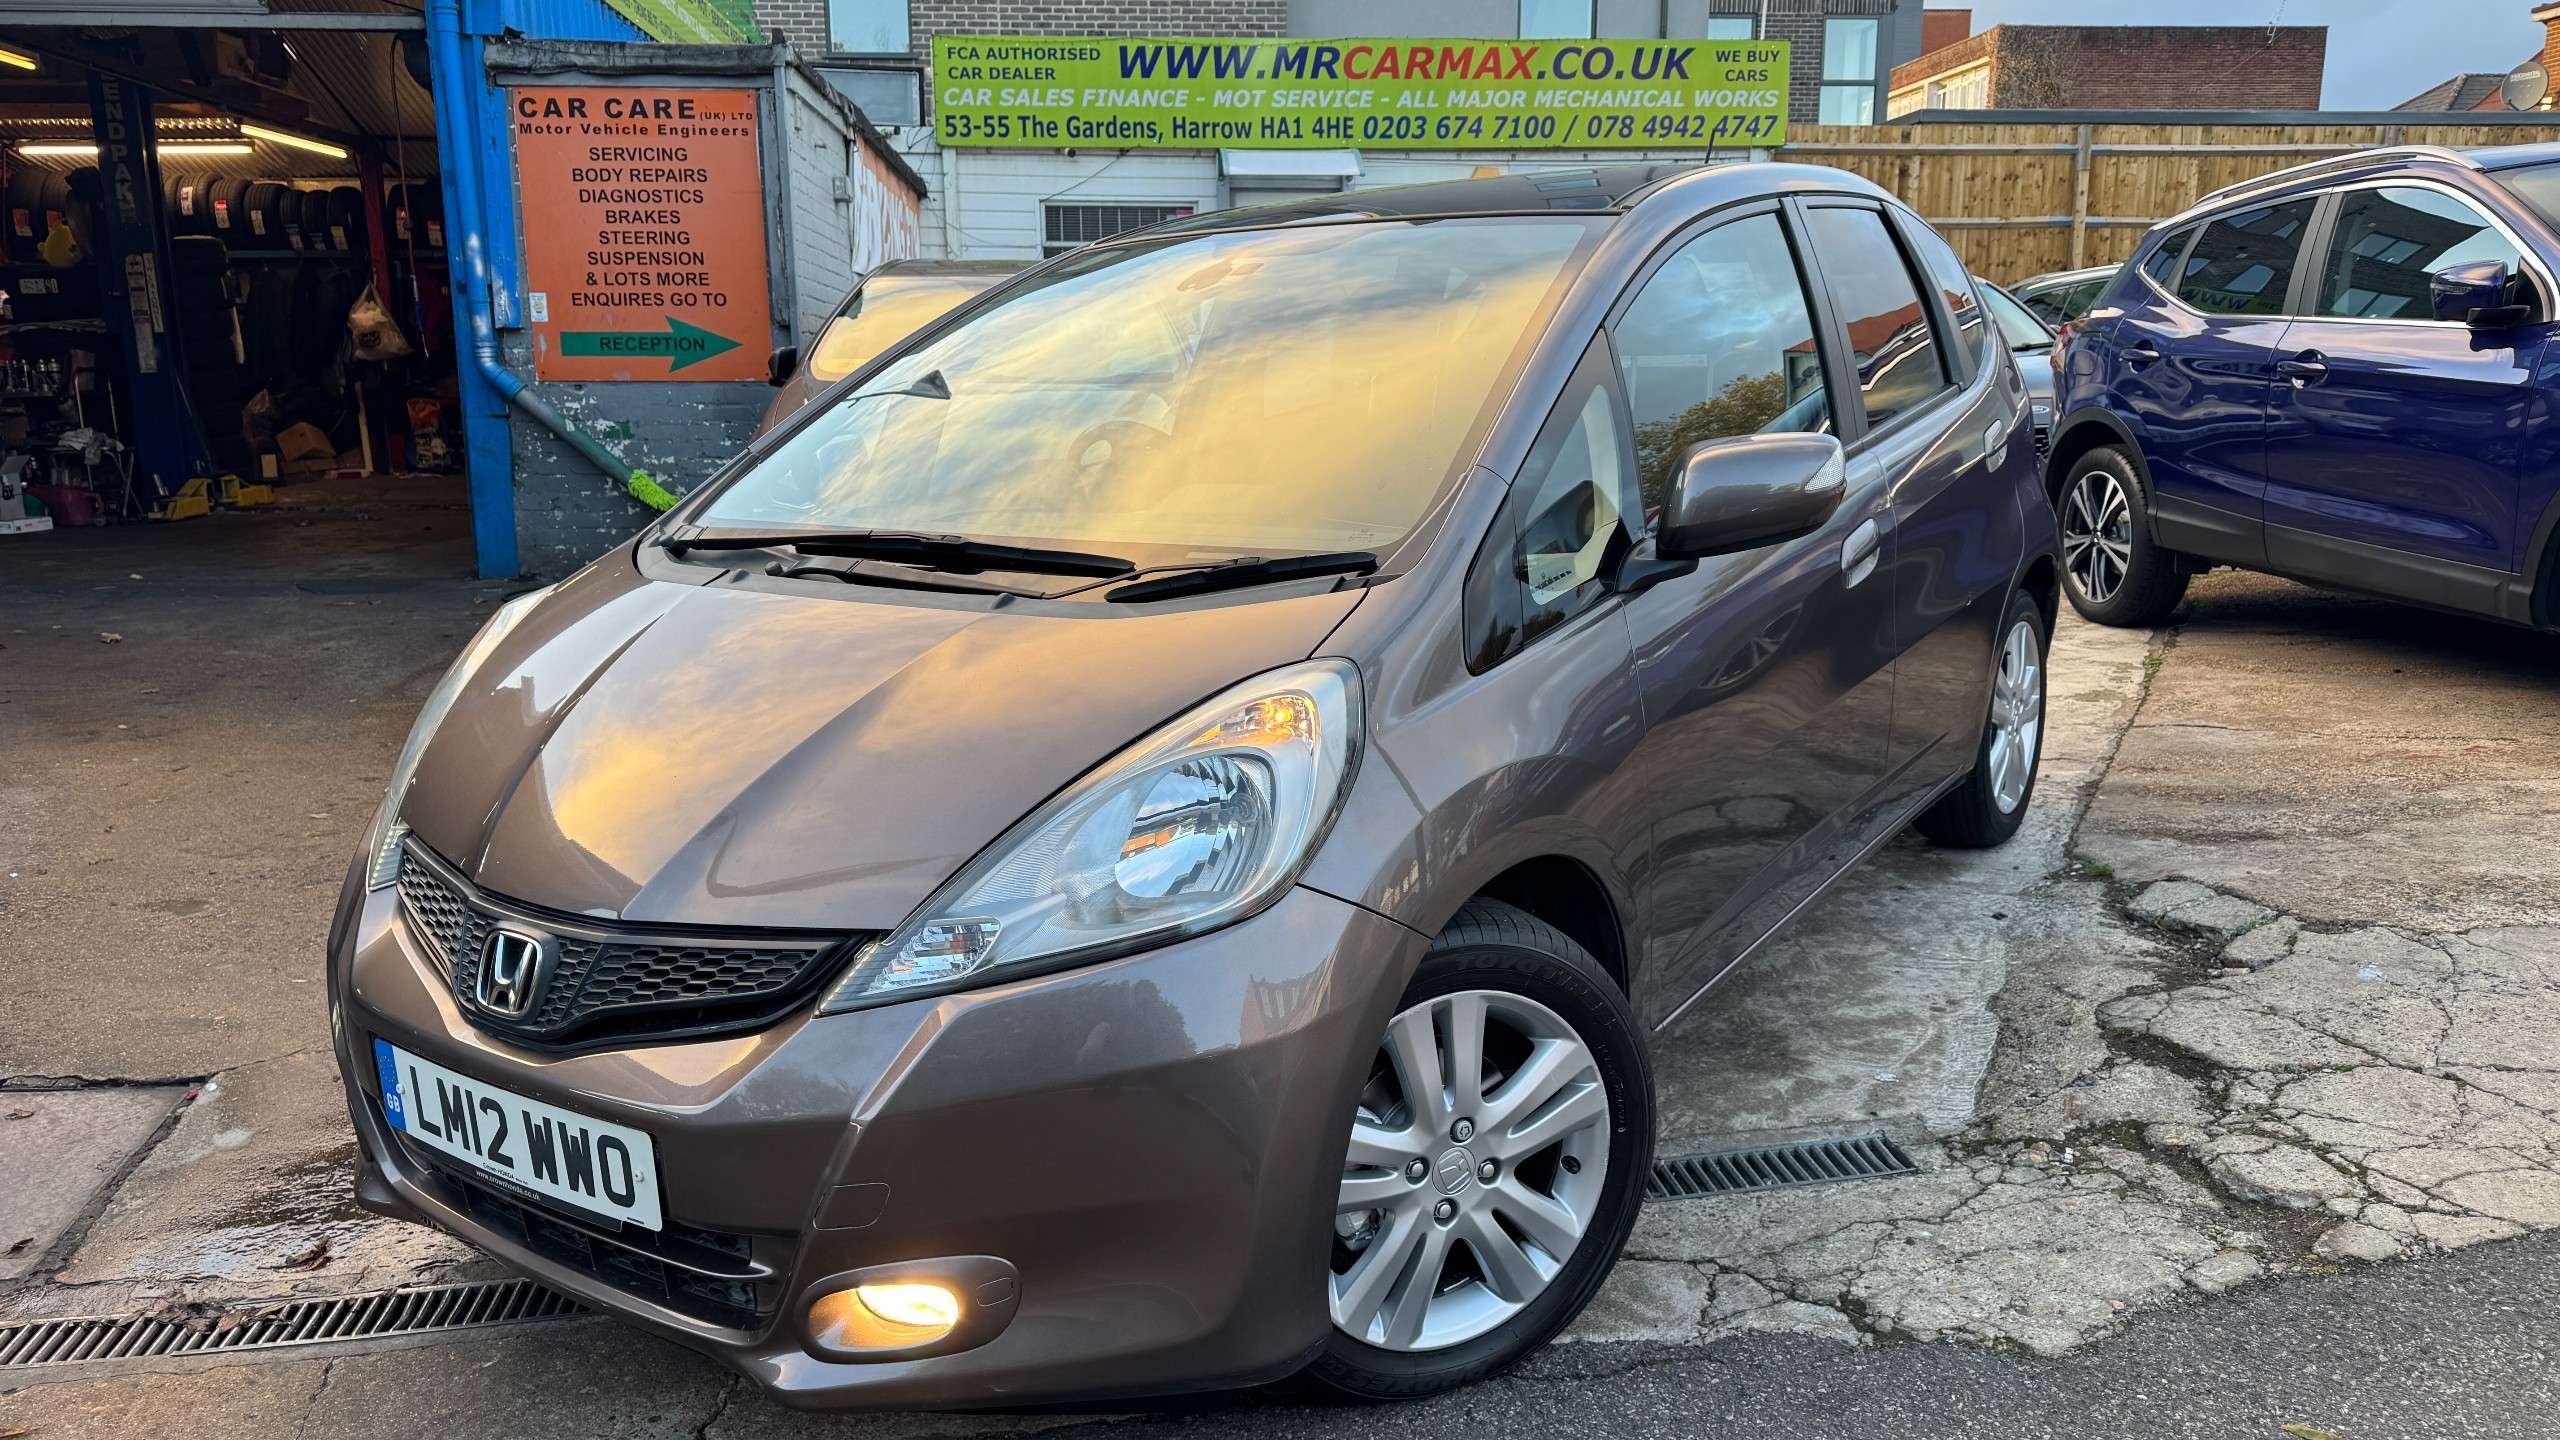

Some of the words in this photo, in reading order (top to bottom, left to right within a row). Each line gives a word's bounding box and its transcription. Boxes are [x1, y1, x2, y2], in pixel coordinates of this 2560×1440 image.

[947, 47, 979, 60] FCA
[986, 47, 1100, 61] AUTHORISED
[1715, 50, 1744, 63] WE
[1748, 50, 1781, 63] BUY
[1118, 45, 1697, 80] WWW.MRCARMAX.CO.UK
[948, 67, 983, 80] CAR
[988, 67, 1056, 80] DEALER
[1725, 69, 1769, 82] CARS
[943, 88, 993, 106] CAR
[999, 88, 1075, 107] SALES
[1081, 89, 1189, 108] FINANCE
[1212, 90, 1262, 108] MOT
[1271, 89, 1374, 108] SERVICE
[1396, 90, 1439, 108] ALL
[1447, 90, 1530, 108] MAJOR
[1535, 89, 1685, 108] MECHANICAL
[1694, 89, 1779, 108] WORKS
[518, 97, 588, 118] CAR
[604, 98, 696, 119] CARE
[699, 112, 726, 122] (UK)
[731, 112, 753, 121] LTD
[519, 123, 572, 135] Motor
[580, 123, 649, 136] Vehicle
[657, 125, 750, 138] Engineers
[944, 114, 1010, 138] 53-55
[1017, 114, 1060, 138] The
[1066, 114, 1164, 143] Gardens,
[1171, 116, 1252, 139] Harrow
[1260, 116, 1304, 139] HA1
[1311, 116, 1354, 139] 4HE
[1362, 115, 1427, 139] 0203
[1436, 115, 1482, 139] 674
[1493, 115, 1556, 139] 7100
[1563, 115, 1579, 142] /
[1586, 115, 1634, 139] 078
[1642, 115, 1706, 139] 4942
[1714, 115, 1779, 139] 4747
[589, 147, 688, 161] SERVICING
[572, 168, 622, 182] BODY
[630, 168, 708, 182] REPAIRS
[579, 189, 704, 203] DIAGNOSTICS
[606, 210, 680, 224] BRAKES
[599, 231, 690, 245] STEERING
[587, 252, 704, 265] SUSPENSION
[586, 273, 598, 286] &
[604, 273, 650, 286] LOTS
[657, 273, 709, 286] MORE
[572, 293, 664, 307] ENQUIRES
[670, 293, 697, 306] GO
[703, 293, 727, 306] TO
[600, 337, 705, 351] RECEPTION
[386, 1093, 400, 1113] GB
[409, 1065, 514, 1169] LM12
[522, 1109, 635, 1208] WWO
